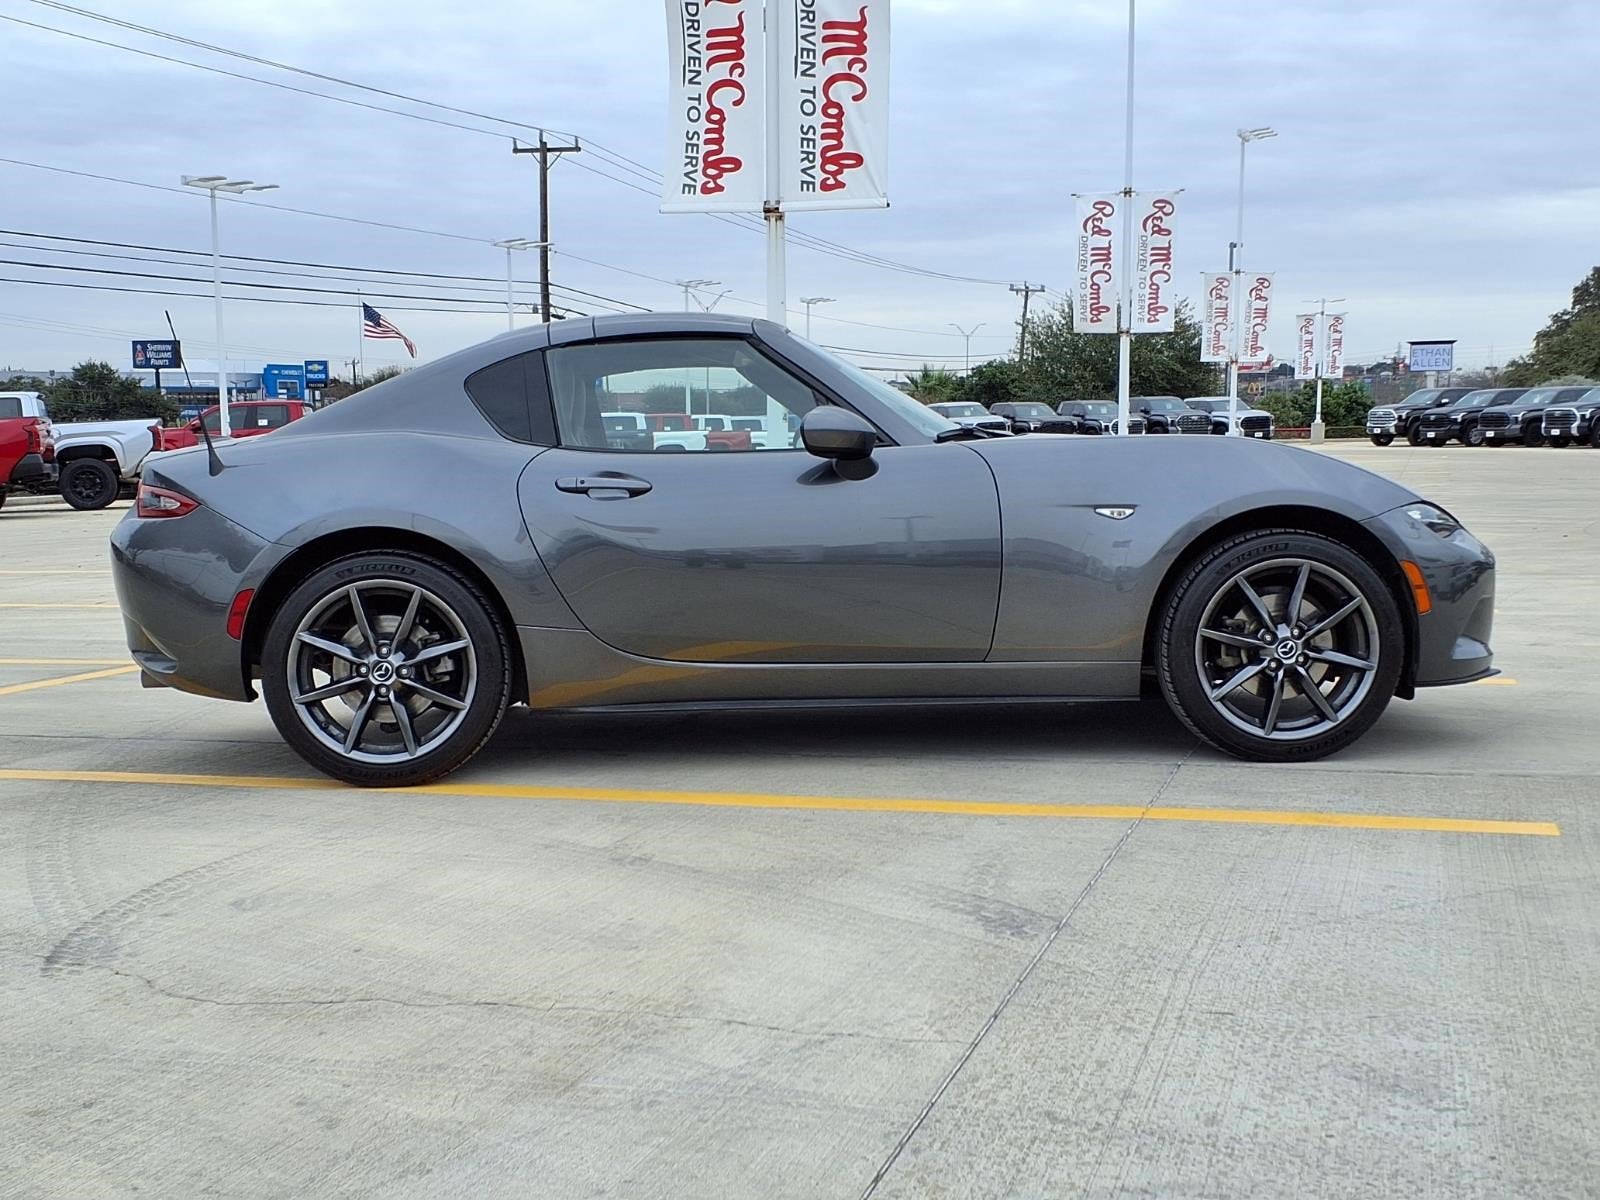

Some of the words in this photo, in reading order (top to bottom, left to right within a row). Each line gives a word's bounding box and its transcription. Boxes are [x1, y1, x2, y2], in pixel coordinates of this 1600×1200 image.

[684, 2, 701, 86] DRIVEN
[686, 93, 701, 123] TO
[700, 10, 745, 194] McCombs
[800, 85, 816, 116] TO
[819, 5, 868, 192] McCombs
[681, 129, 700, 195] SERVE
[800, 124, 816, 193] SERVE
[1083, 200, 1115, 237] Red
[1142, 199, 1174, 237] Red
[1080, 236, 1088, 272] DRIVEN
[1139, 235, 1148, 272] DRIVEN
[1079, 277, 1087, 290] TO
[1089, 240, 1112, 323] McCombs
[1138, 277, 1146, 290] TO
[1147, 239, 1172, 323] McCombs
[1209, 277, 1230, 301] Red
[1249, 277, 1271, 301] Red
[1079, 293, 1087, 323] SERVE
[1137, 293, 1146, 323] SERVE
[1412, 347, 1450, 357] ETHAN
[1412, 358, 1450, 367] ALLEN
